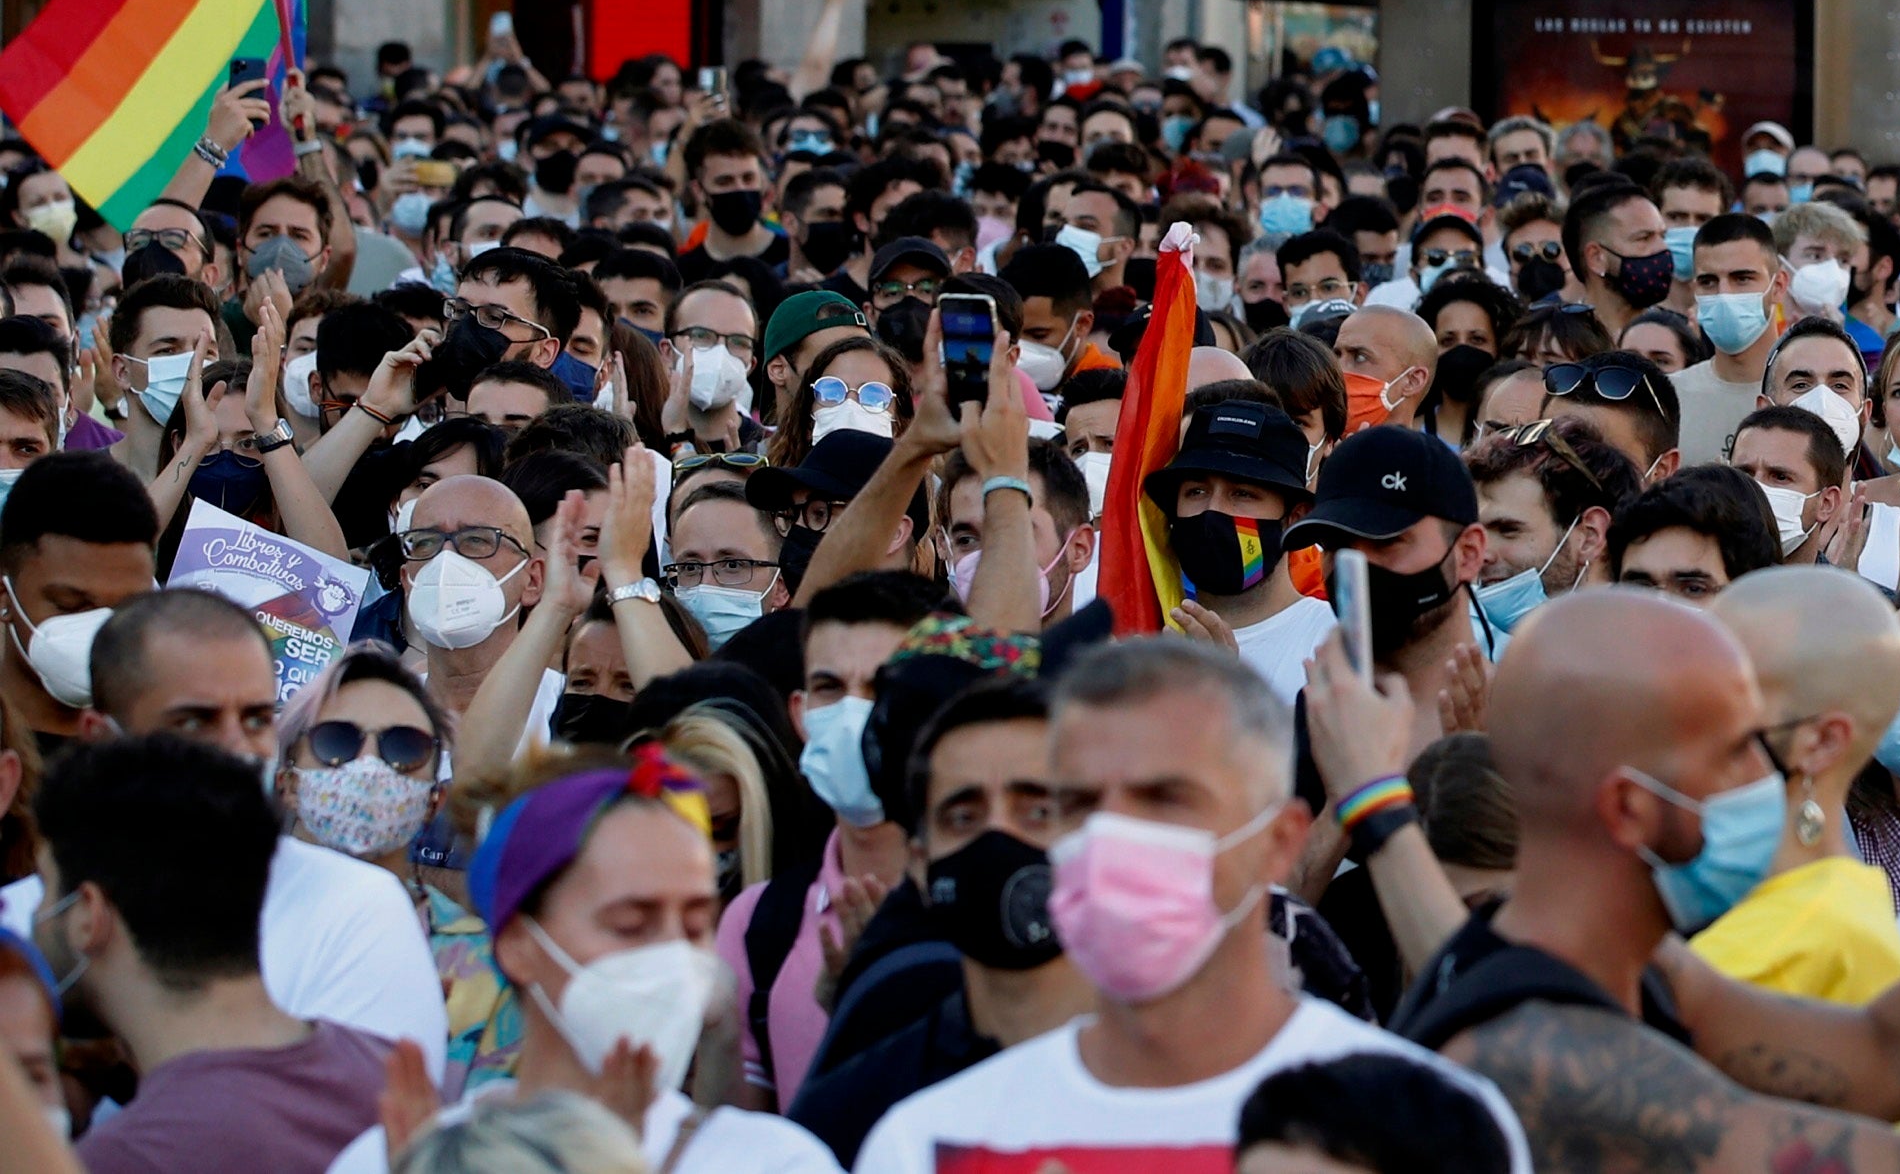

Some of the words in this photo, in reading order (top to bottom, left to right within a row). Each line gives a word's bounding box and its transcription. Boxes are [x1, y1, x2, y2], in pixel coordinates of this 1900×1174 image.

[1381, 470, 1408, 492] ck
[226, 524, 287, 559] Libres
[286, 553, 303, 569] y
[202, 538, 307, 591] Combativas
[255, 610, 335, 650] QUEREMOS
[284, 637, 332, 668] SER
[287, 666, 316, 684] QU
